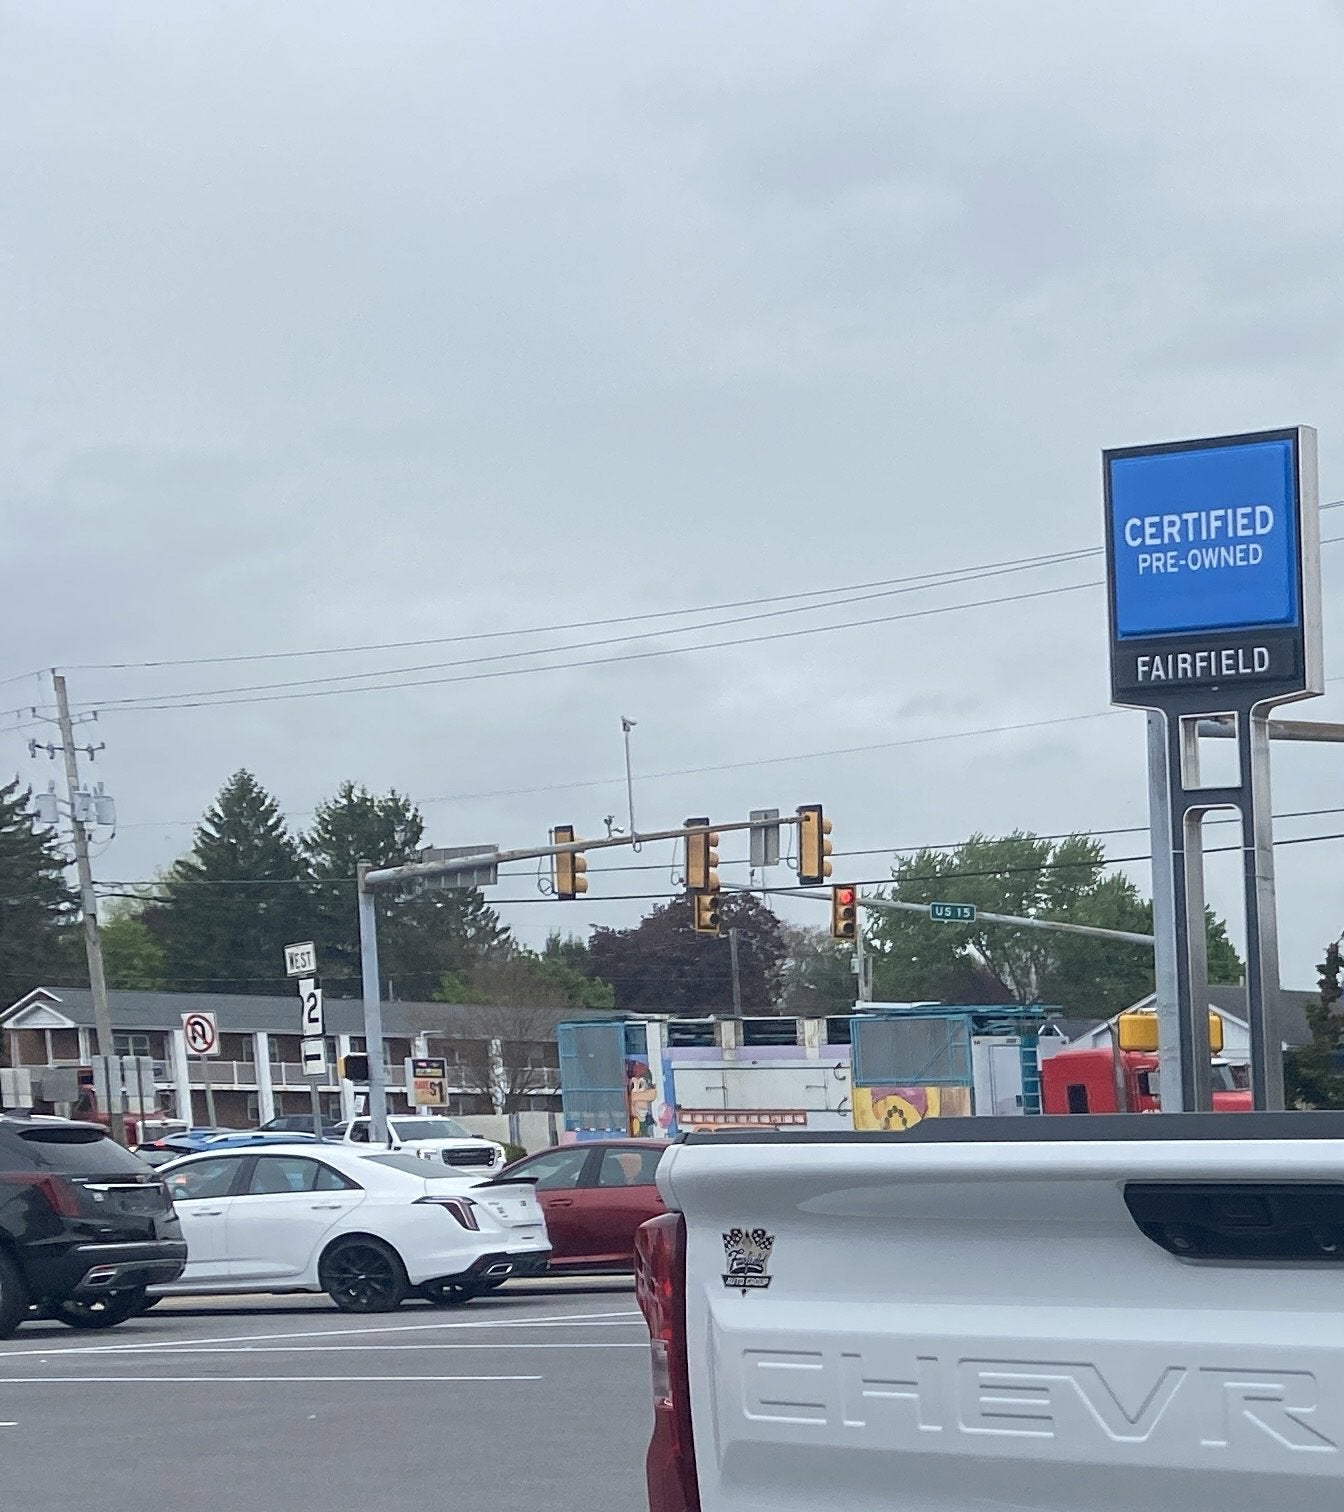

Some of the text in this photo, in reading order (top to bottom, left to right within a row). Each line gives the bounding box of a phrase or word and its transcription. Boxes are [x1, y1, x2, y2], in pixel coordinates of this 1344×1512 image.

[1124, 505, 1274, 547] CERTIFIED
[1138, 543, 1263, 575] PRE-OWNED
[1137, 646, 1270, 682] FAIRFIELD
[935, 906, 971, 918] US 15
[288, 951, 311, 970] WEST
